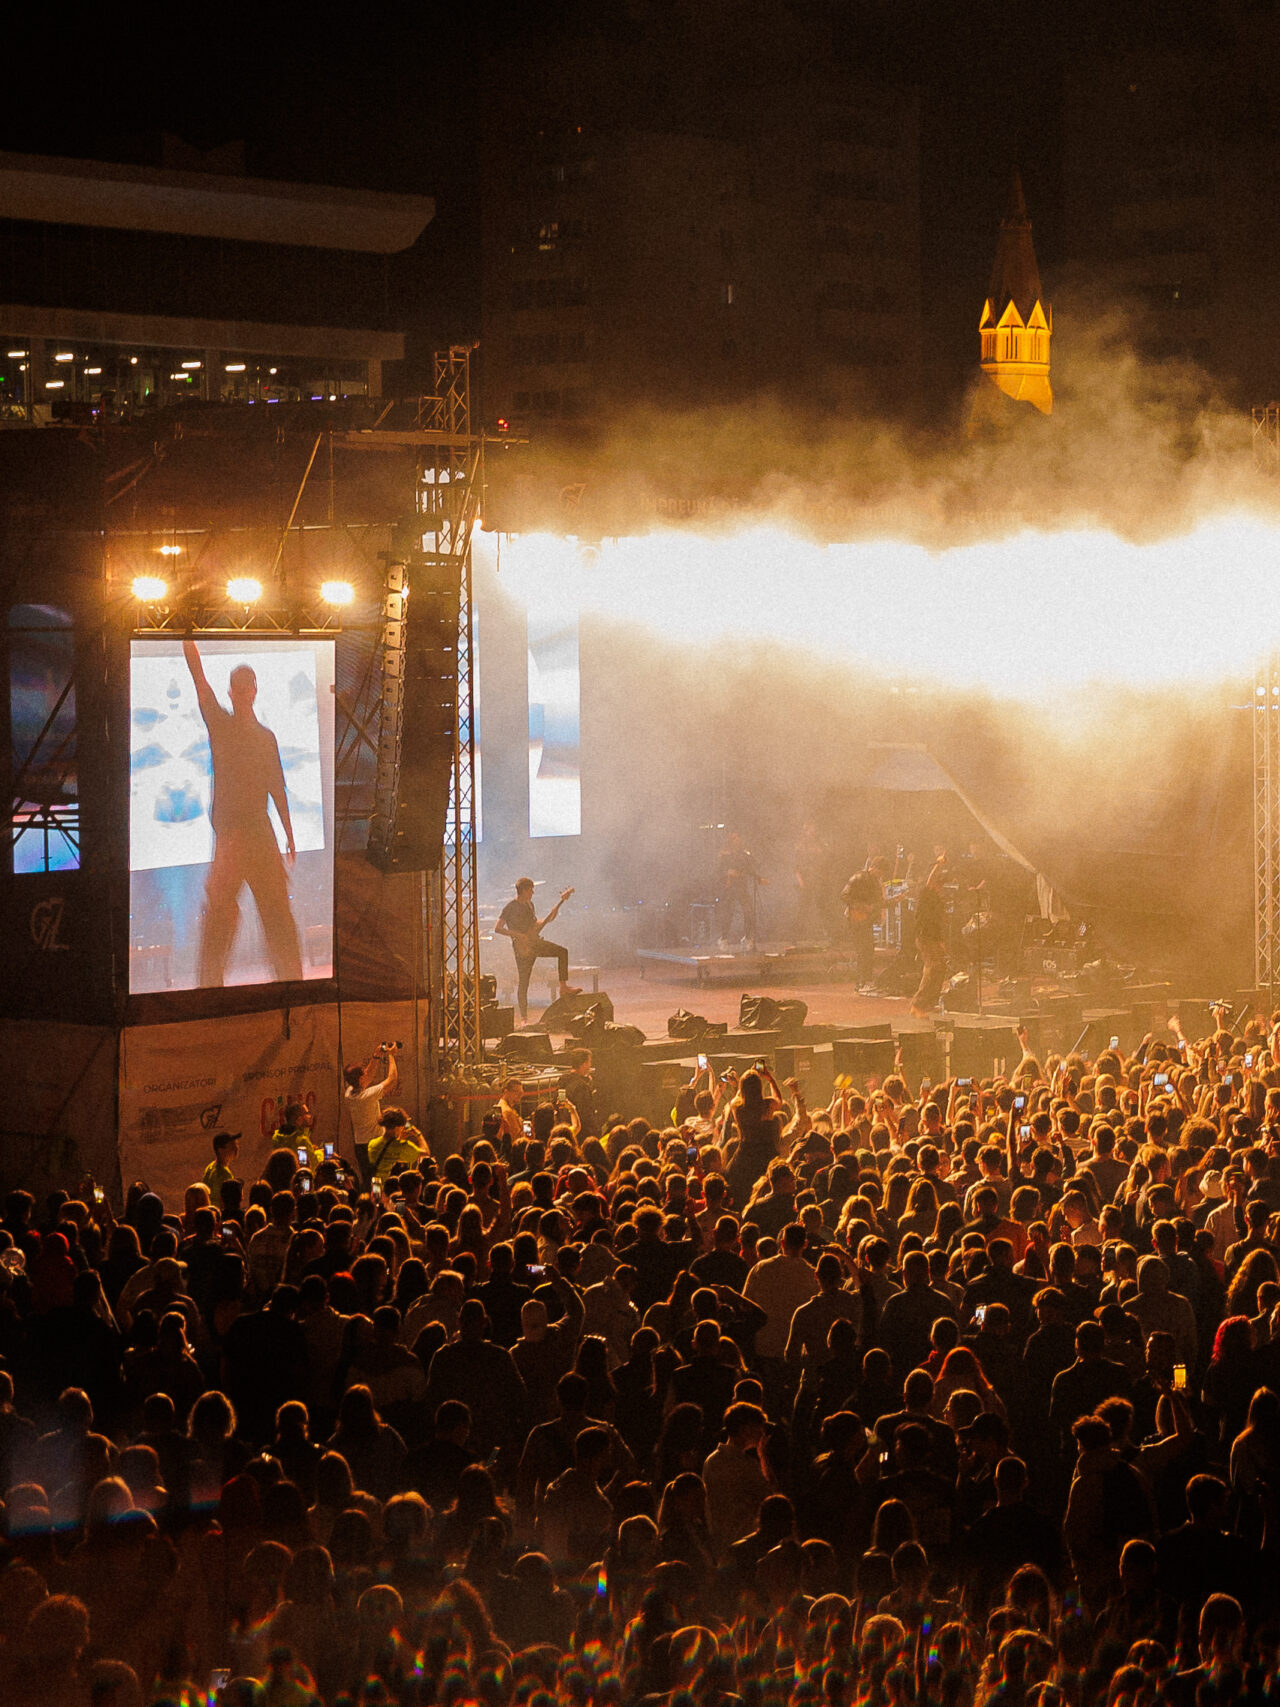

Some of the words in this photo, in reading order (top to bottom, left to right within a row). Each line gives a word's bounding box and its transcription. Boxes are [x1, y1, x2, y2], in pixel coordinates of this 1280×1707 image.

[242, 1067, 287, 1083] SPONSOR
[288, 1061, 332, 1076] PRINCIPAL
[143, 1077, 217, 1094] ORGANIZATORI
